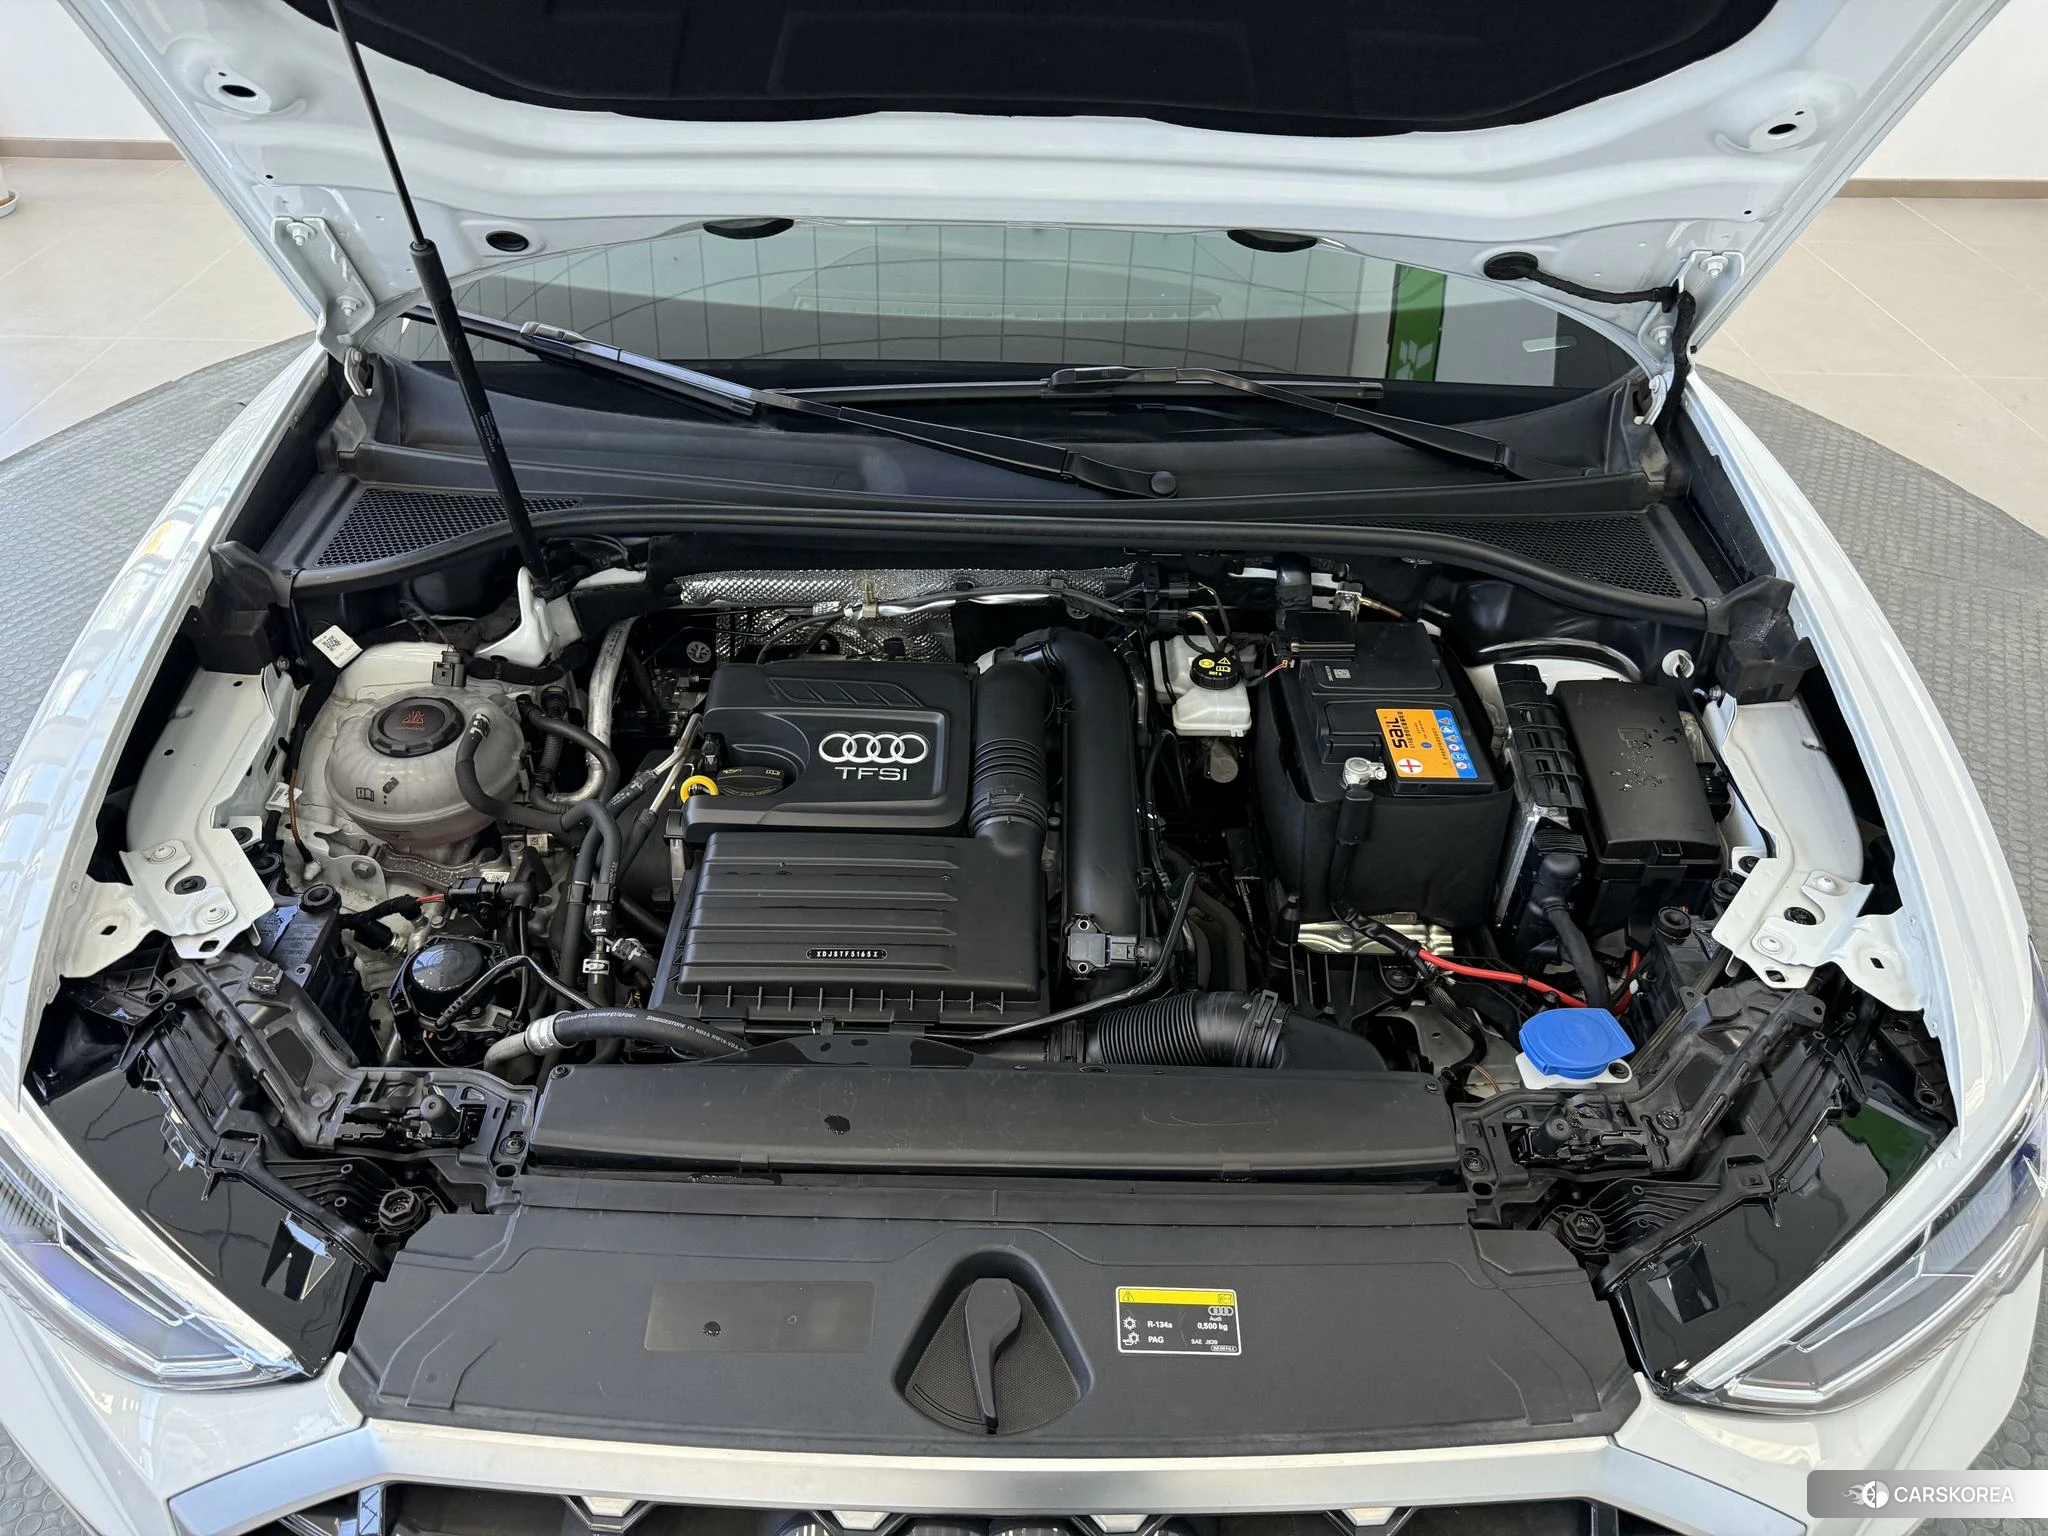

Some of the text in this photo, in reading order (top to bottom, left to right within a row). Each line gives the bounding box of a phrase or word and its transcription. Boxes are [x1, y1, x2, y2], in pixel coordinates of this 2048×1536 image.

[834, 766, 908, 781] TFSI
[1147, 1320, 1228, 1331] R-134a 0,500 kg
